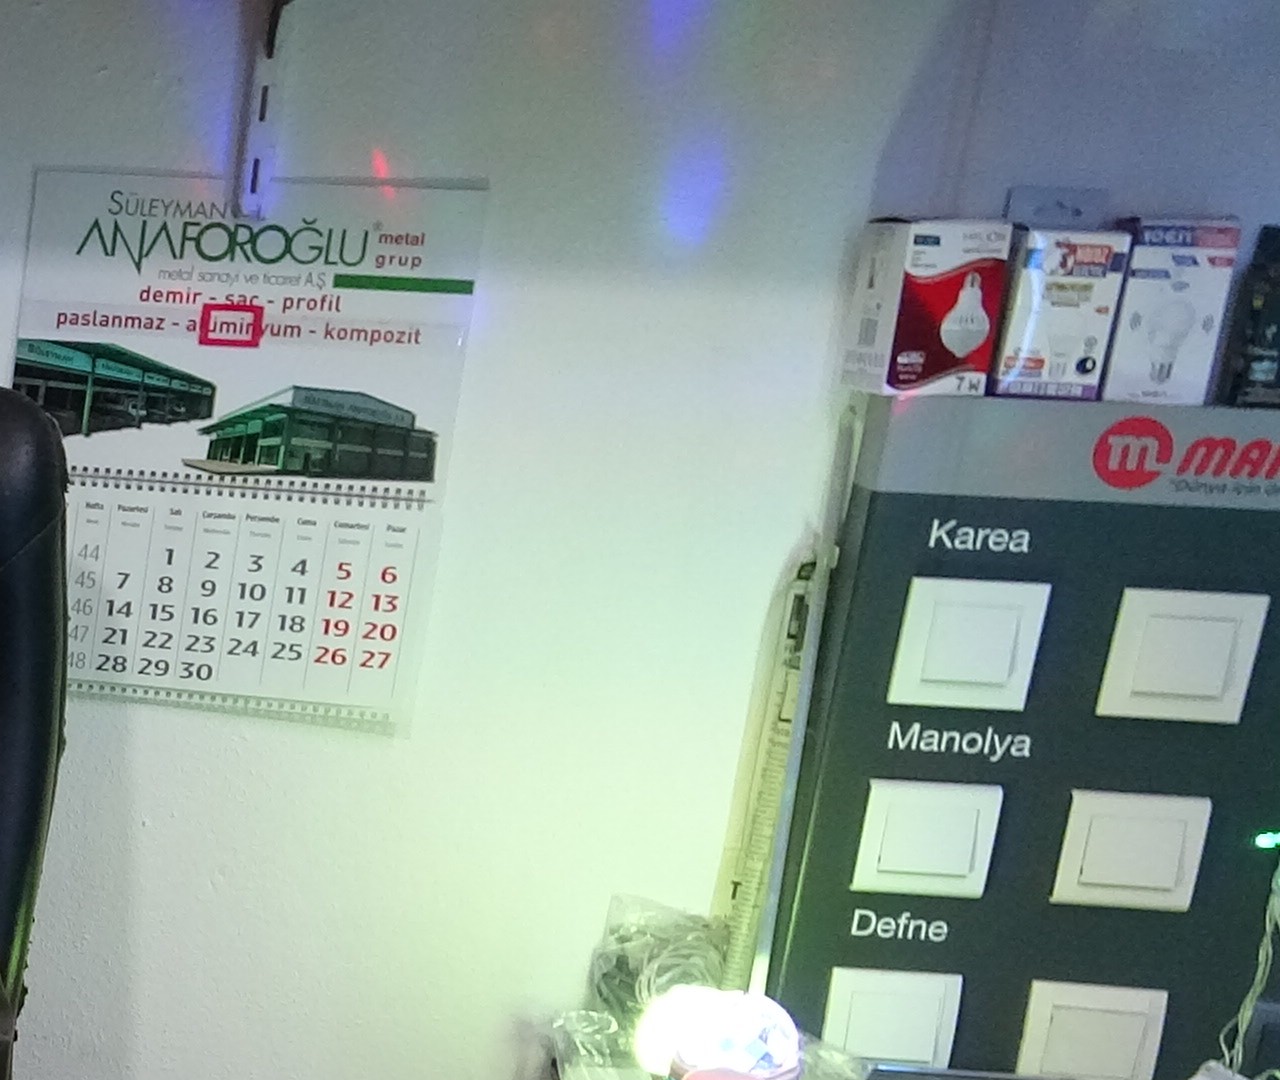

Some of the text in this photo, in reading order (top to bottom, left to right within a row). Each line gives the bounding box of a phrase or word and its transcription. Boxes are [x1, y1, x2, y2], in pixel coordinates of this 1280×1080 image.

[75, 216, 370, 275] ANAFOROĞLU
[378, 231, 426, 247] metal
[375, 253, 423, 270] grup
[139, 284, 203, 305] demir
[282, 289, 342, 314] profil
[56, 309, 166, 333] paslanmaz
[323, 322, 422, 346] kompozit
[928, 519, 1030, 554] Karea
[78, 544, 397, 584] 44 1 2 3 4 5 6
[74, 571, 398, 612] 45 7 8 9 10 11 12 13
[70, 598, 396, 641] 46 14 15 16 17 18 19 20
[68, 625, 391, 669] 47 21 22 23 24 25 26 27
[67, 652, 212, 681] 48 28 29 30
[887, 720, 1032, 762] Manolya
[851, 908, 949, 942] Defne
